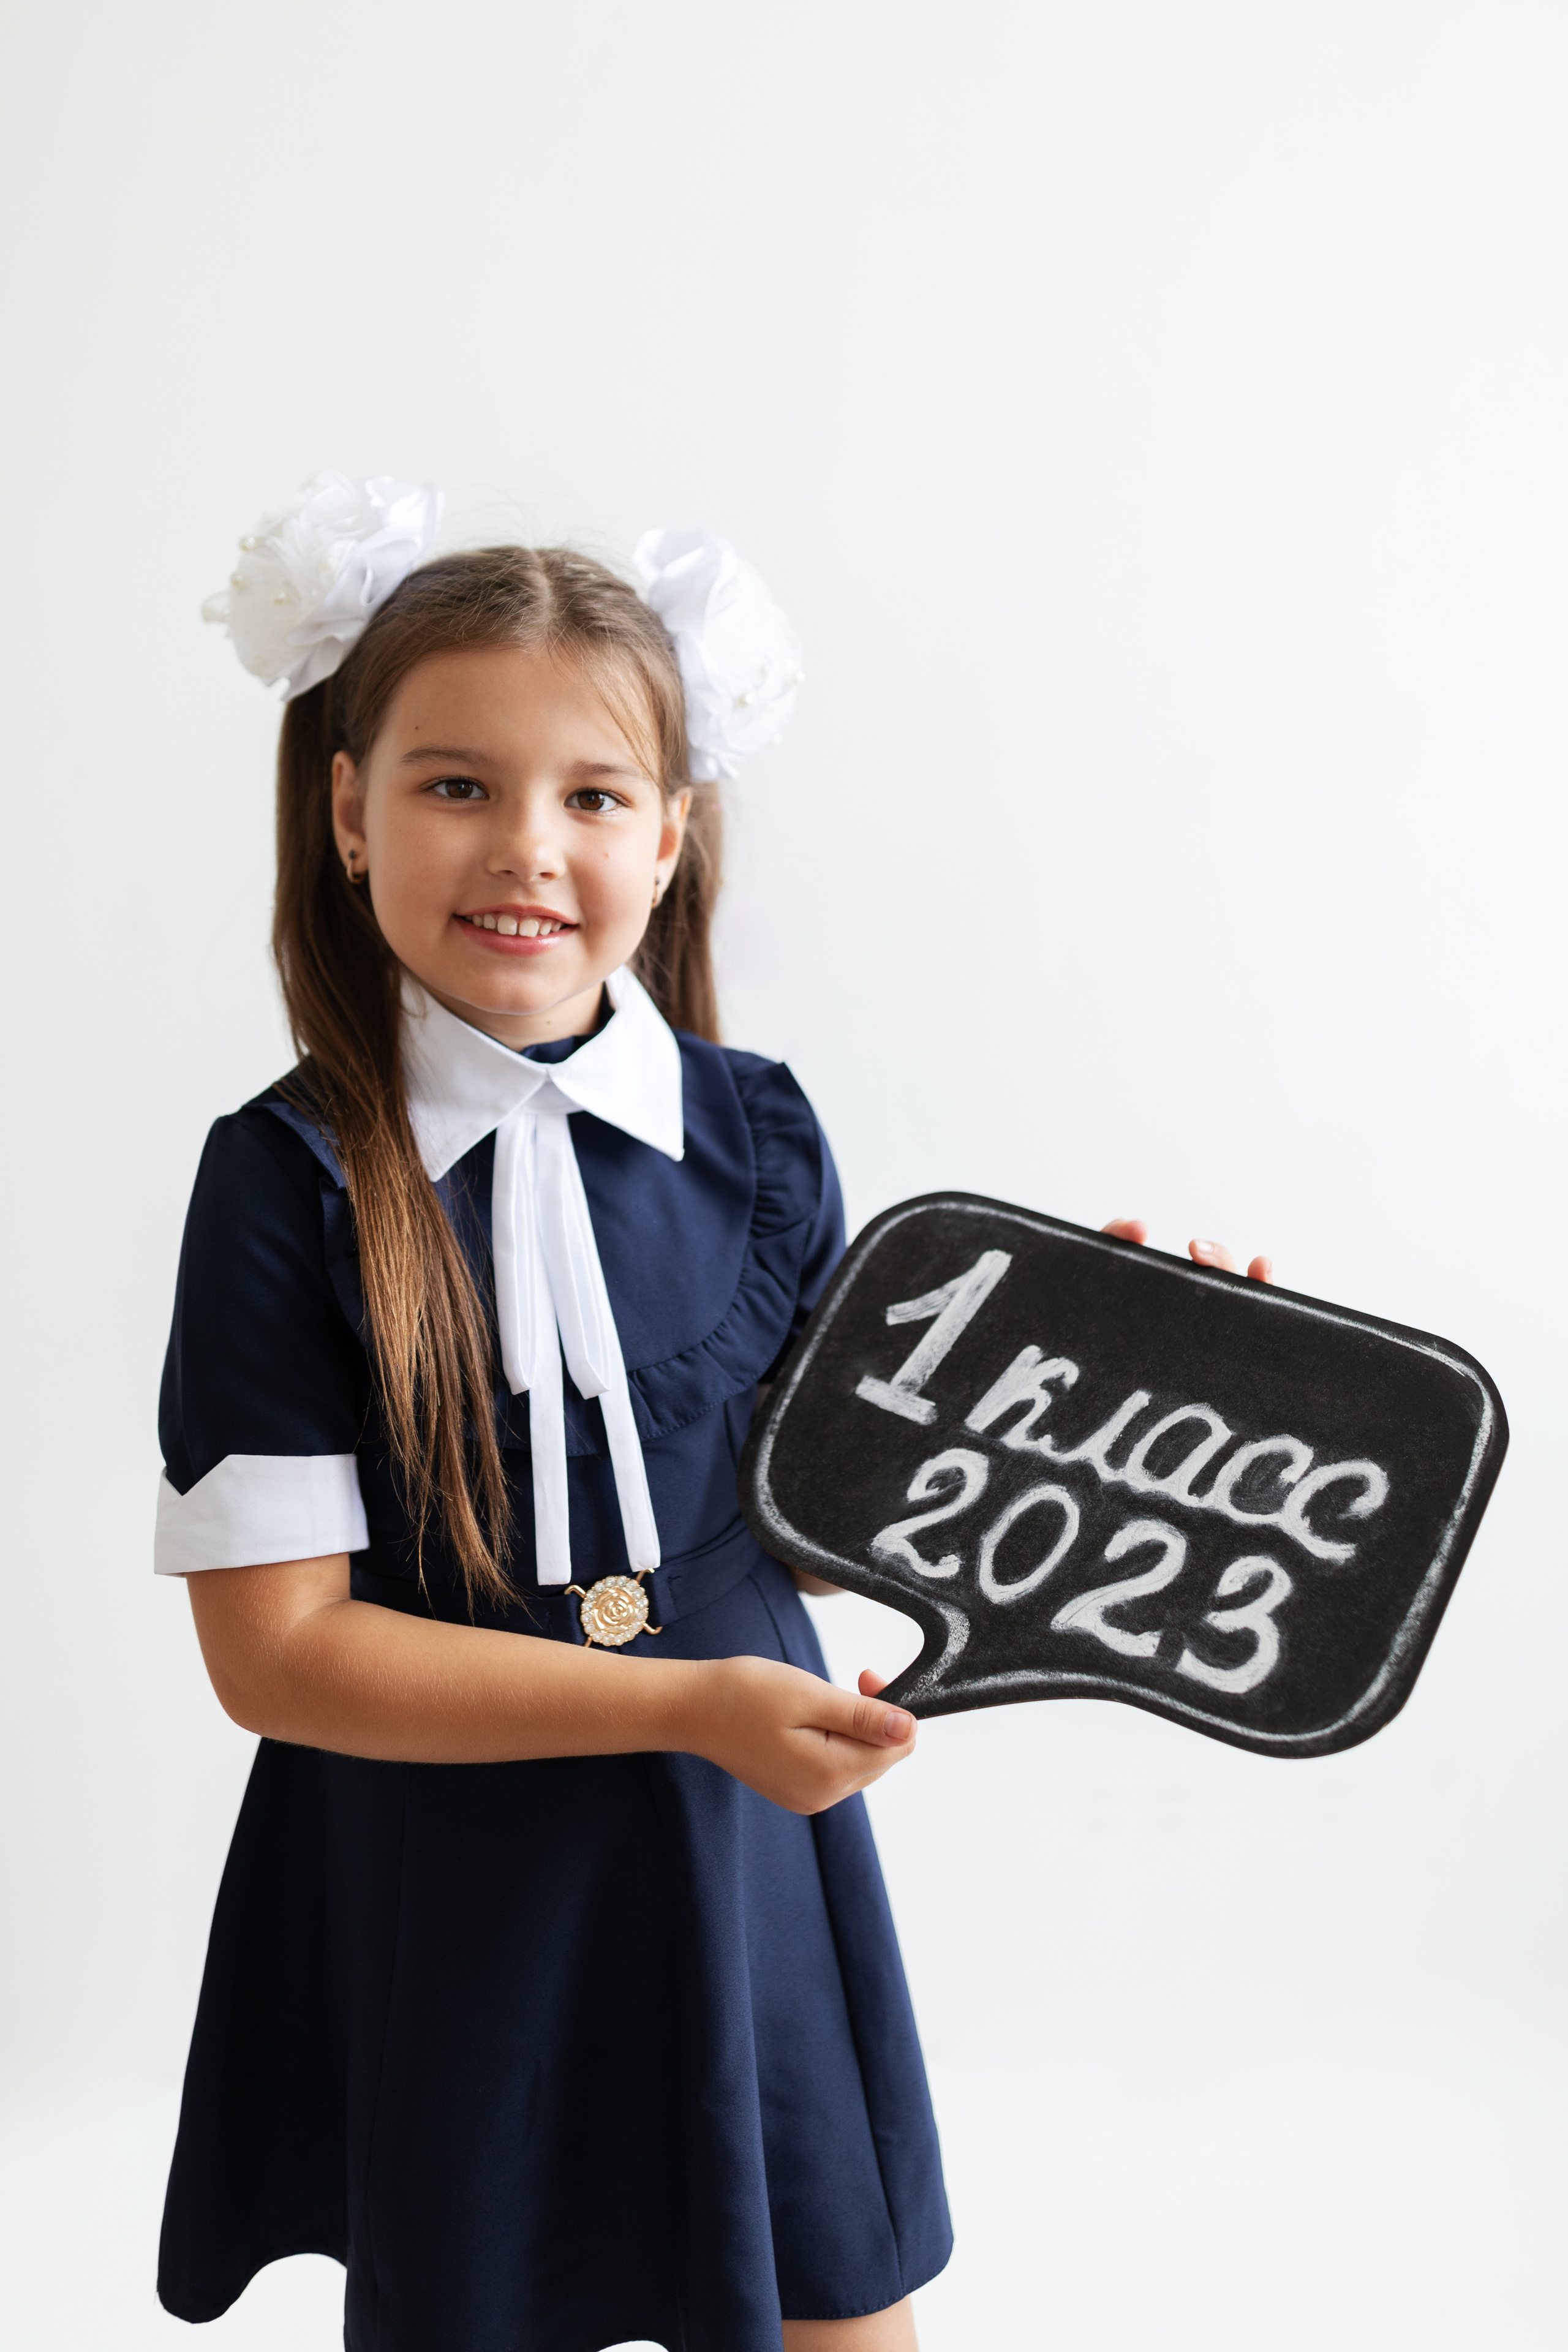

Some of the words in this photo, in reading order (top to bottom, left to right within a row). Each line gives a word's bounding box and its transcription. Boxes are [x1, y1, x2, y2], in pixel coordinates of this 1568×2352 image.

[855, 1250, 1012, 1426] 1
[964, 1344, 1390, 1566] класс
[868, 1447, 1294, 1694] 2023
